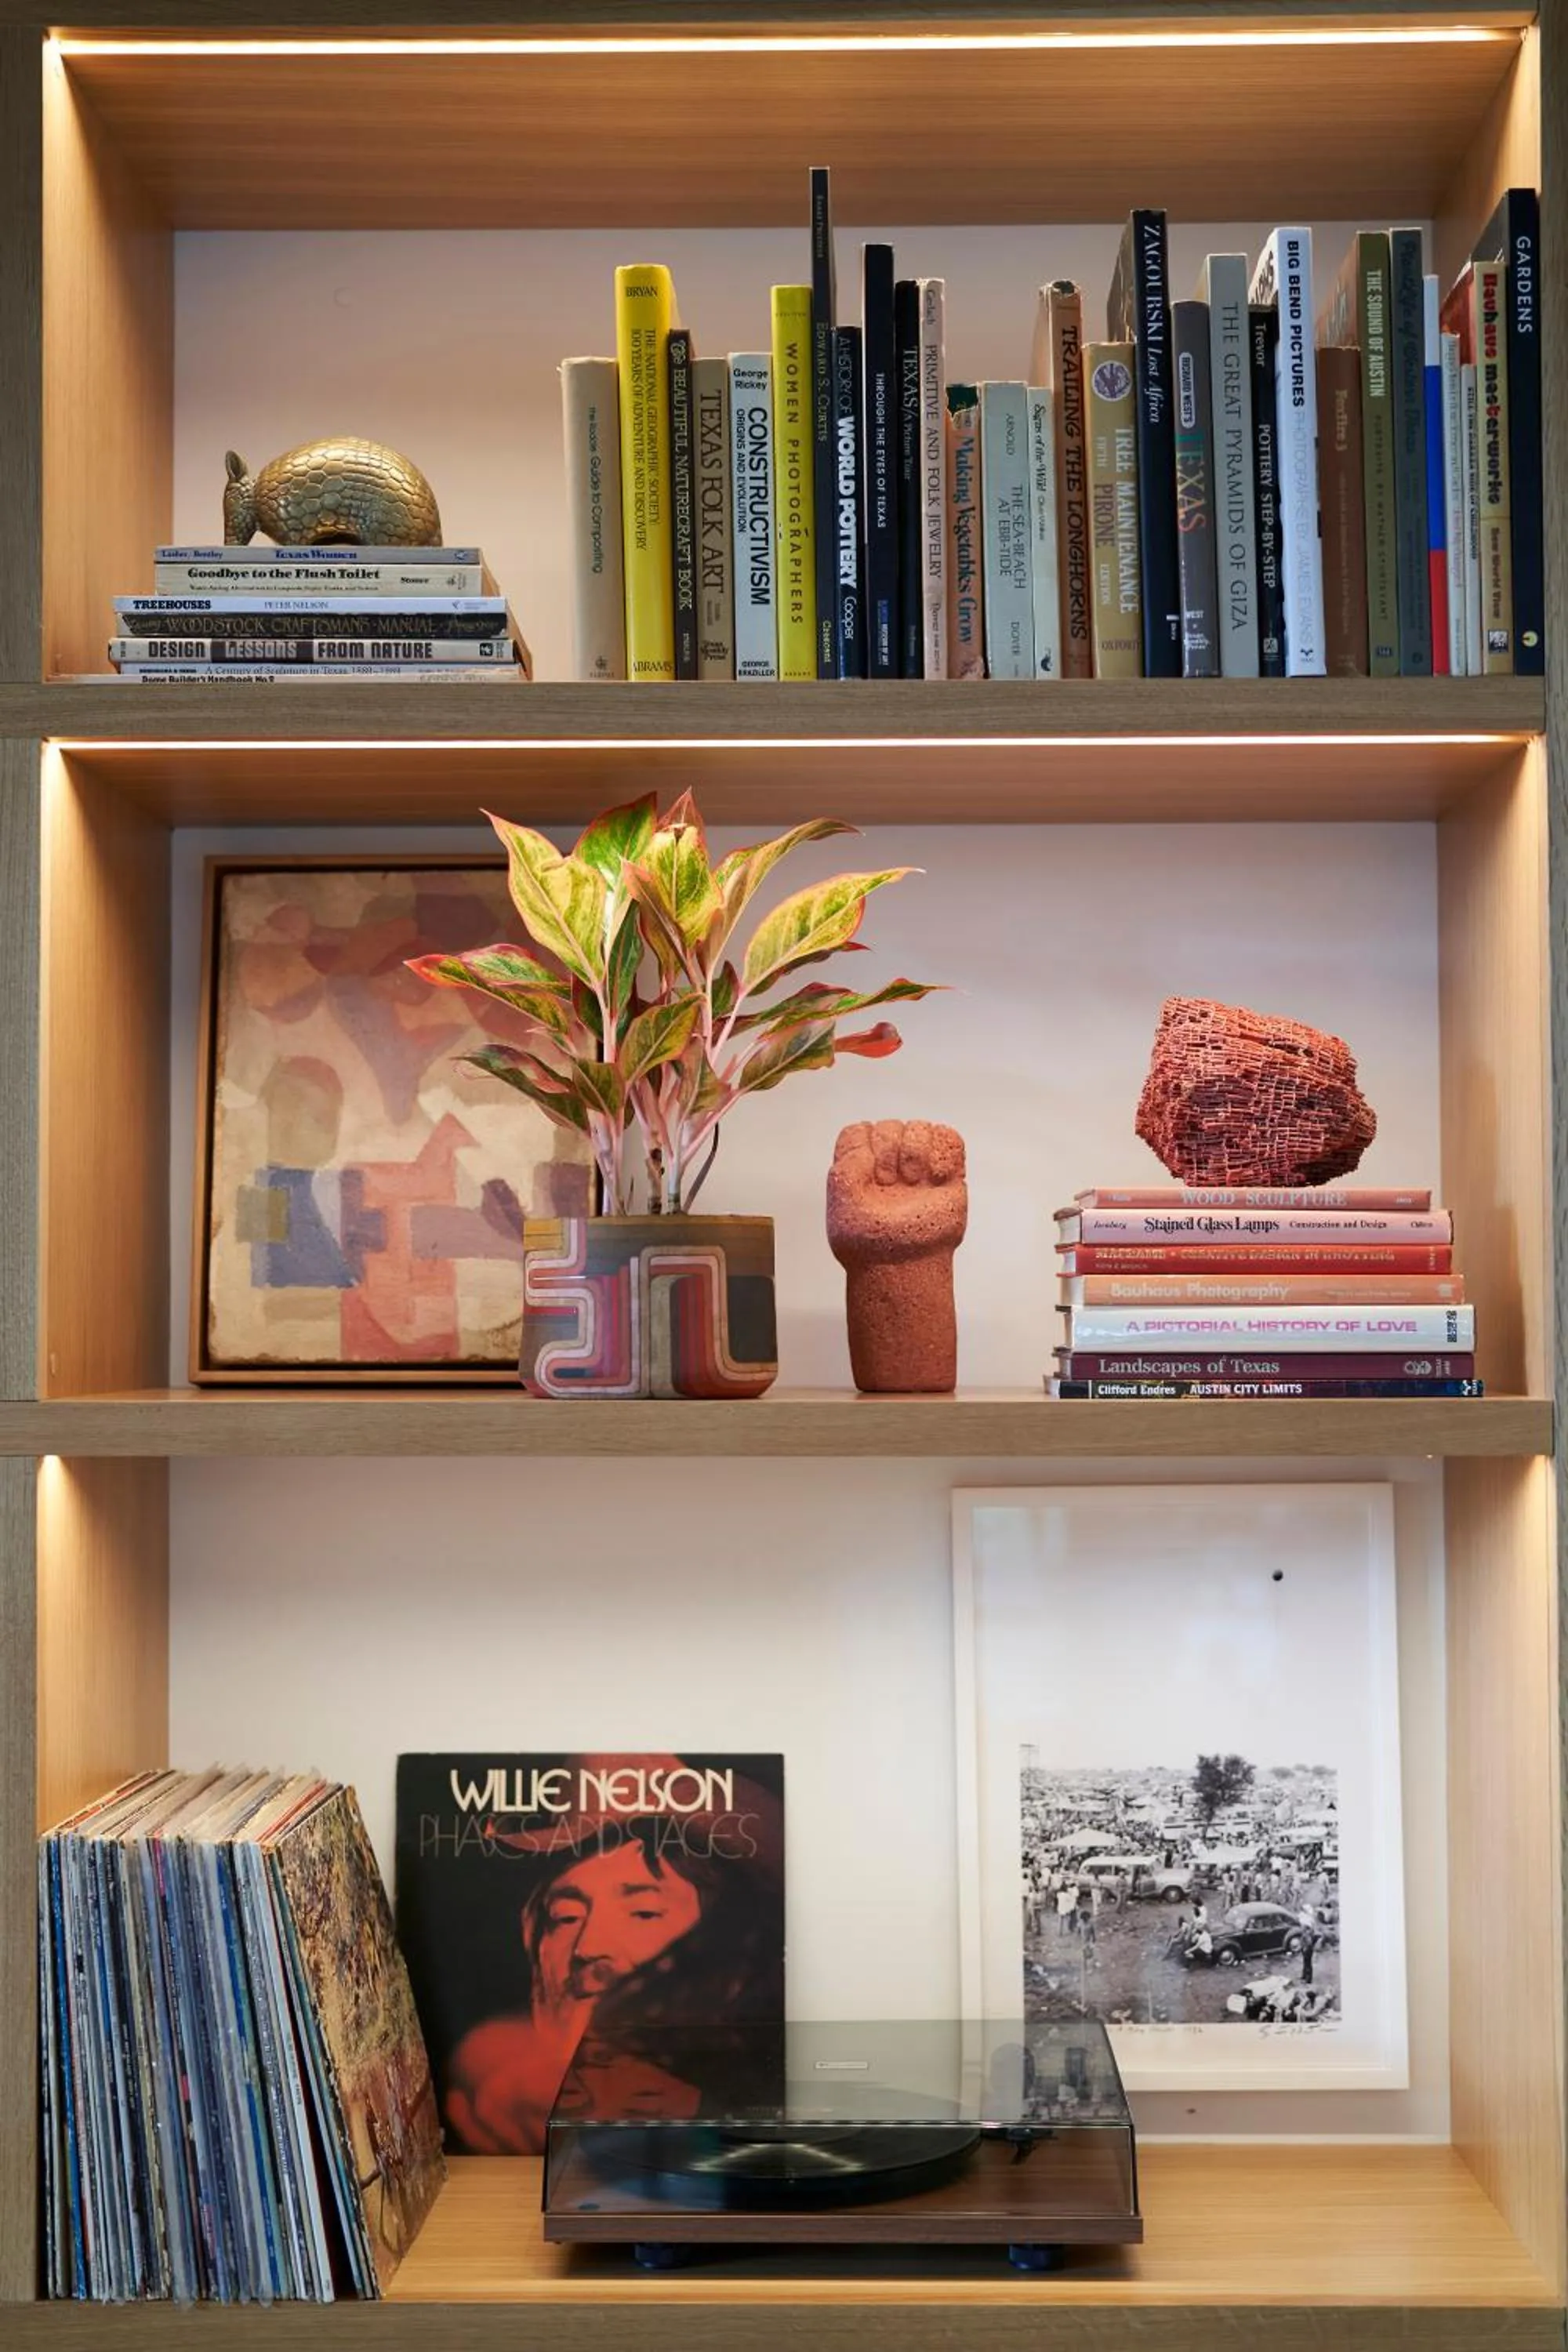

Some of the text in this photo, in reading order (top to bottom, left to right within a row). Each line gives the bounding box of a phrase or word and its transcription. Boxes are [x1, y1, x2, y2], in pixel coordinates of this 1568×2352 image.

[1367, 270, 1381, 292] THE
[1516, 235, 1534, 334] GARDENS
[1143, 224, 1164, 424] ZAGOURSKI Lost Africa
[1287, 241, 1305, 408] BIG BEND PICTURES
[1367, 294, 1383, 335] SOUND
[816, 321, 829, 375] EDWARD
[1255, 323, 1268, 367] Trevor
[1369, 336, 1384, 351] OF
[733, 368, 769, 380] George
[735, 380, 768, 392] Rickey
[1370, 354, 1385, 397] AUSTIN
[1483, 273, 1504, 505] Bauhaus masterworks
[645, 329, 661, 526] THE NATIONAL GEOGRAPHIC SOCIETY
[699, 389, 723, 471] TEXAS
[817, 394, 831, 441] CURTIS
[1004, 413, 1016, 456] ARNOLD
[1033, 403, 1047, 434] Signs
[1034, 435, 1046, 446] of
[590, 456, 602, 491] Guide
[631, 349, 647, 551] YEARS OF ADVENTURE AND DISCOVERY
[735, 408, 748, 534] ORIGINS AND EVOLUTION
[837, 415, 856, 495] WORLD
[875, 372, 887, 528] THROUGH THE EYES OF TEXAS
[925, 343, 942, 579] PRIMITIVE AND FOLK JEWELRY
[952, 435, 976, 504] Making
[1035, 446, 1047, 463] the
[1222, 301, 1249, 631] THE GREAT PYRAMIDS OF GIZA
[591, 493, 602, 505] to
[673, 368, 693, 612] BEAUTIFUL NATURECRAFT BOOK
[786, 343, 804, 624] WOMEN PHOTOGRAPHERS
[1035, 463, 1048, 492] Wild
[1061, 325, 1089, 641] TRAILING THE LONGHORNS
[1174, 429, 1208, 533] TEXAS
[700, 476, 724, 538] FOLK
[748, 407, 771, 606] CONSTRUCTIVISM
[1093, 483, 1116, 549] PIRONE
[1115, 427, 1140, 615] TREE MAINTENANCE
[1258, 423, 1276, 589] POTTERY STEP-BY-STEP
[276, 550, 358, 559] Texas Women
[590, 506, 604, 574] Composting
[838, 498, 858, 590] POTTERY
[953, 505, 978, 593] Vegetables
[997, 498, 1013, 577] AT EBB-TIDE
[1010, 484, 1027, 589] THE SEA-BEACH
[187, 568, 380, 581] Goodbye to the Flush Toilet
[702, 543, 725, 594] ART
[1099, 564, 1112, 605] EDITION
[132, 600, 211, 610] TREEHOUSES
[166, 615, 266, 633] WOODSTOCK
[841, 596, 858, 640] Cooper
[957, 597, 978, 644] Grow
[148, 641, 433, 659] DESIGN LESSONS FROM NATURE
[1181, 1190, 1347, 1207] WOOD SCULPTURE
[1144, 1216, 1280, 1234] Stained Glass Lamps
[1289, 1219, 1388, 1230] Construction and Design
[1110, 1282, 1291, 1301] Bauhaus Photography
[1126, 1320, 1418, 1332] A PICTORIAL HISTORY OF LOVE
[1098, 1356, 1280, 1377] Landscapes of Texas
[1098, 1384, 1177, 1395] Clifford Endres
[1189, 1384, 1302, 1395] AUSTIN CITY LIMITS
[450, 1769, 733, 1813] WILLIE NELSON
[419, 1813, 760, 1860] PHASES AND STAGES
